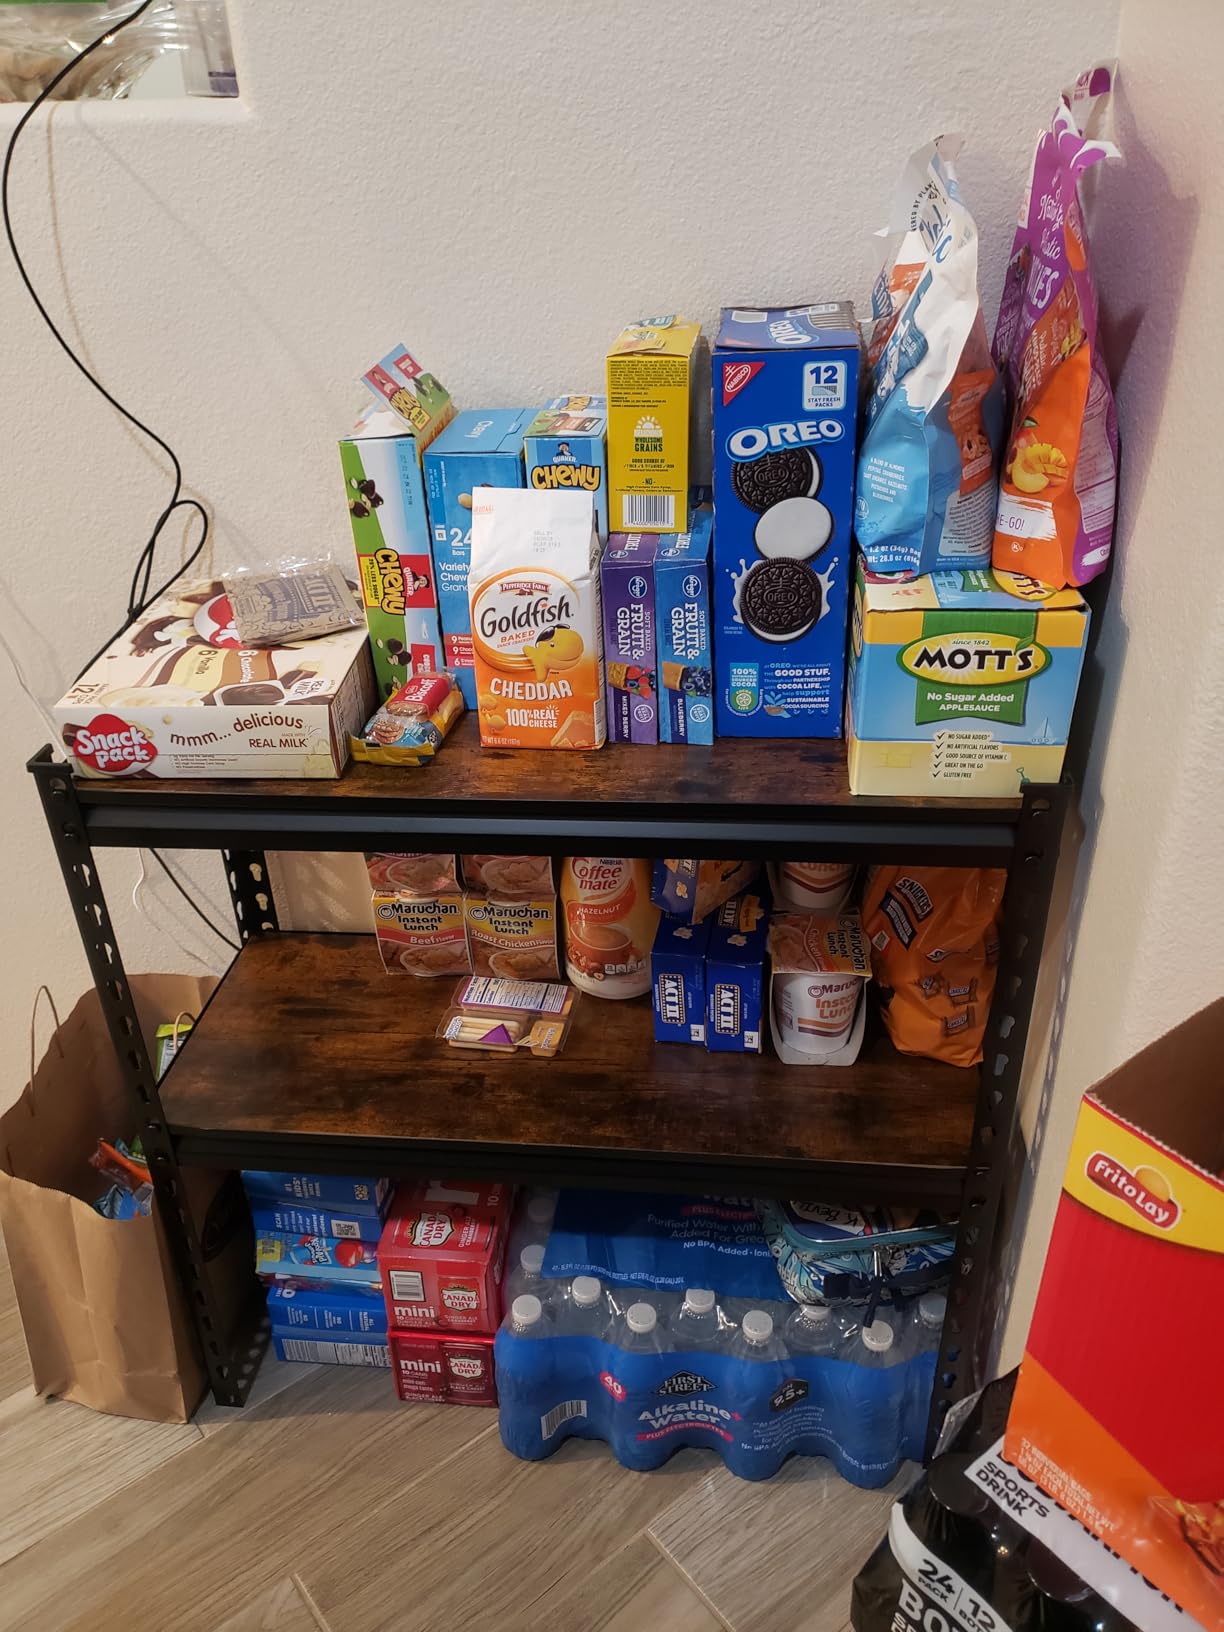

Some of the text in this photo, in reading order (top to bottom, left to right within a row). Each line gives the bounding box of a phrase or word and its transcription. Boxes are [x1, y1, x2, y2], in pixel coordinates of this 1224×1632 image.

[810, 365, 838, 385] 12
[730, 419, 843, 457] OREO
[634, 443, 663, 452] GRAINS
[552, 455, 577, 464] QUAKER
[758, 470, 786, 482] OREO
[441, 573, 469, 582] Chew
[502, 581, 547, 592] PEPPERIDGE FARM
[767, 592, 795, 601] OREO
[452, 635, 457, 643] 9
[500, 629, 535, 644] BAKED
[617, 607, 630, 656] GRAIN
[631, 604, 644, 660] FRUIT &
[671, 607, 685, 656] GRAIN
[685, 603, 699, 660] FRUIT &
[453, 647, 458, 655] 9
[454, 658, 460, 666] 6
[774, 668, 831, 677] GOOD STUF.
[405, 678, 437, 702] Biscoff
[490, 677, 573, 701] CHEDDAR
[927, 692, 1014, 703] No Sugar Added
[939, 703, 1001, 712] APPLESAUCE
[505, 708, 557, 727] 100% REAL
[529, 719, 558, 729] CHEESE
[677, 698, 685, 736] BLUEBERRY
[170, 711, 304, 747] mmm... delicious
[75, 726, 148, 755] Snack
[249, 739, 307, 748] REAL MILK
[96, 744, 150, 769] pack
[572, 857, 622, 881] Coffee
[579, 878, 617, 891] mate
[900, 878, 932, 912] SNICKERS
[391, 902, 457, 915] Maruchan
[483, 906, 549, 919] Maruchan
[578, 904, 620, 916] HAZELNUT
[397, 915, 443, 924] Instant
[489, 919, 534, 928] Instant
[471, 929, 497, 944] Roast
[499, 938, 536, 948] Chicken
[494, 926, 529, 935] Lunch
[410, 934, 455, 945] Beef Flavor
[826, 932, 837, 955] Lunch
[839, 929, 849, 958] Instant
[849, 927, 867, 972] Maruchan
[1093, 1158, 1170, 1225] Frito Lay
[487, 1195, 499, 1207] 10
[274, 1213, 282, 1229] SCAN
[433, 1219, 448, 1240] DRY
[647, 1213, 689, 1229] Purified
[692, 1219, 730, 1231] Water
[458, 1226, 469, 1248] GINGER
[671, 1228, 764, 1244] Added For Grea
[683, 1240, 748, 1257] No BPA Added
[442, 1292, 480, 1303] CANADA
[451, 1300, 472, 1308] DRY
[394, 1305, 435, 1318] mini
[400, 1359, 441, 1374] mini
[604, 1376, 623, 1395] 40
[658, 1383, 711, 1396] STREET
[664, 1375, 704, 1387] FIRST
[638, 1399, 731, 1421] Alkaline
[650, 1411, 720, 1429] Water
[646, 1422, 725, 1439] PLUS ELECTROLYTES
[975, 1469, 1027, 1517] DRINK
[983, 1461, 1051, 1518] SPORTS
[918, 1558, 955, 1594] 24
[918, 1577, 949, 1603] PACK
[968, 1599, 997, 1630] 12
